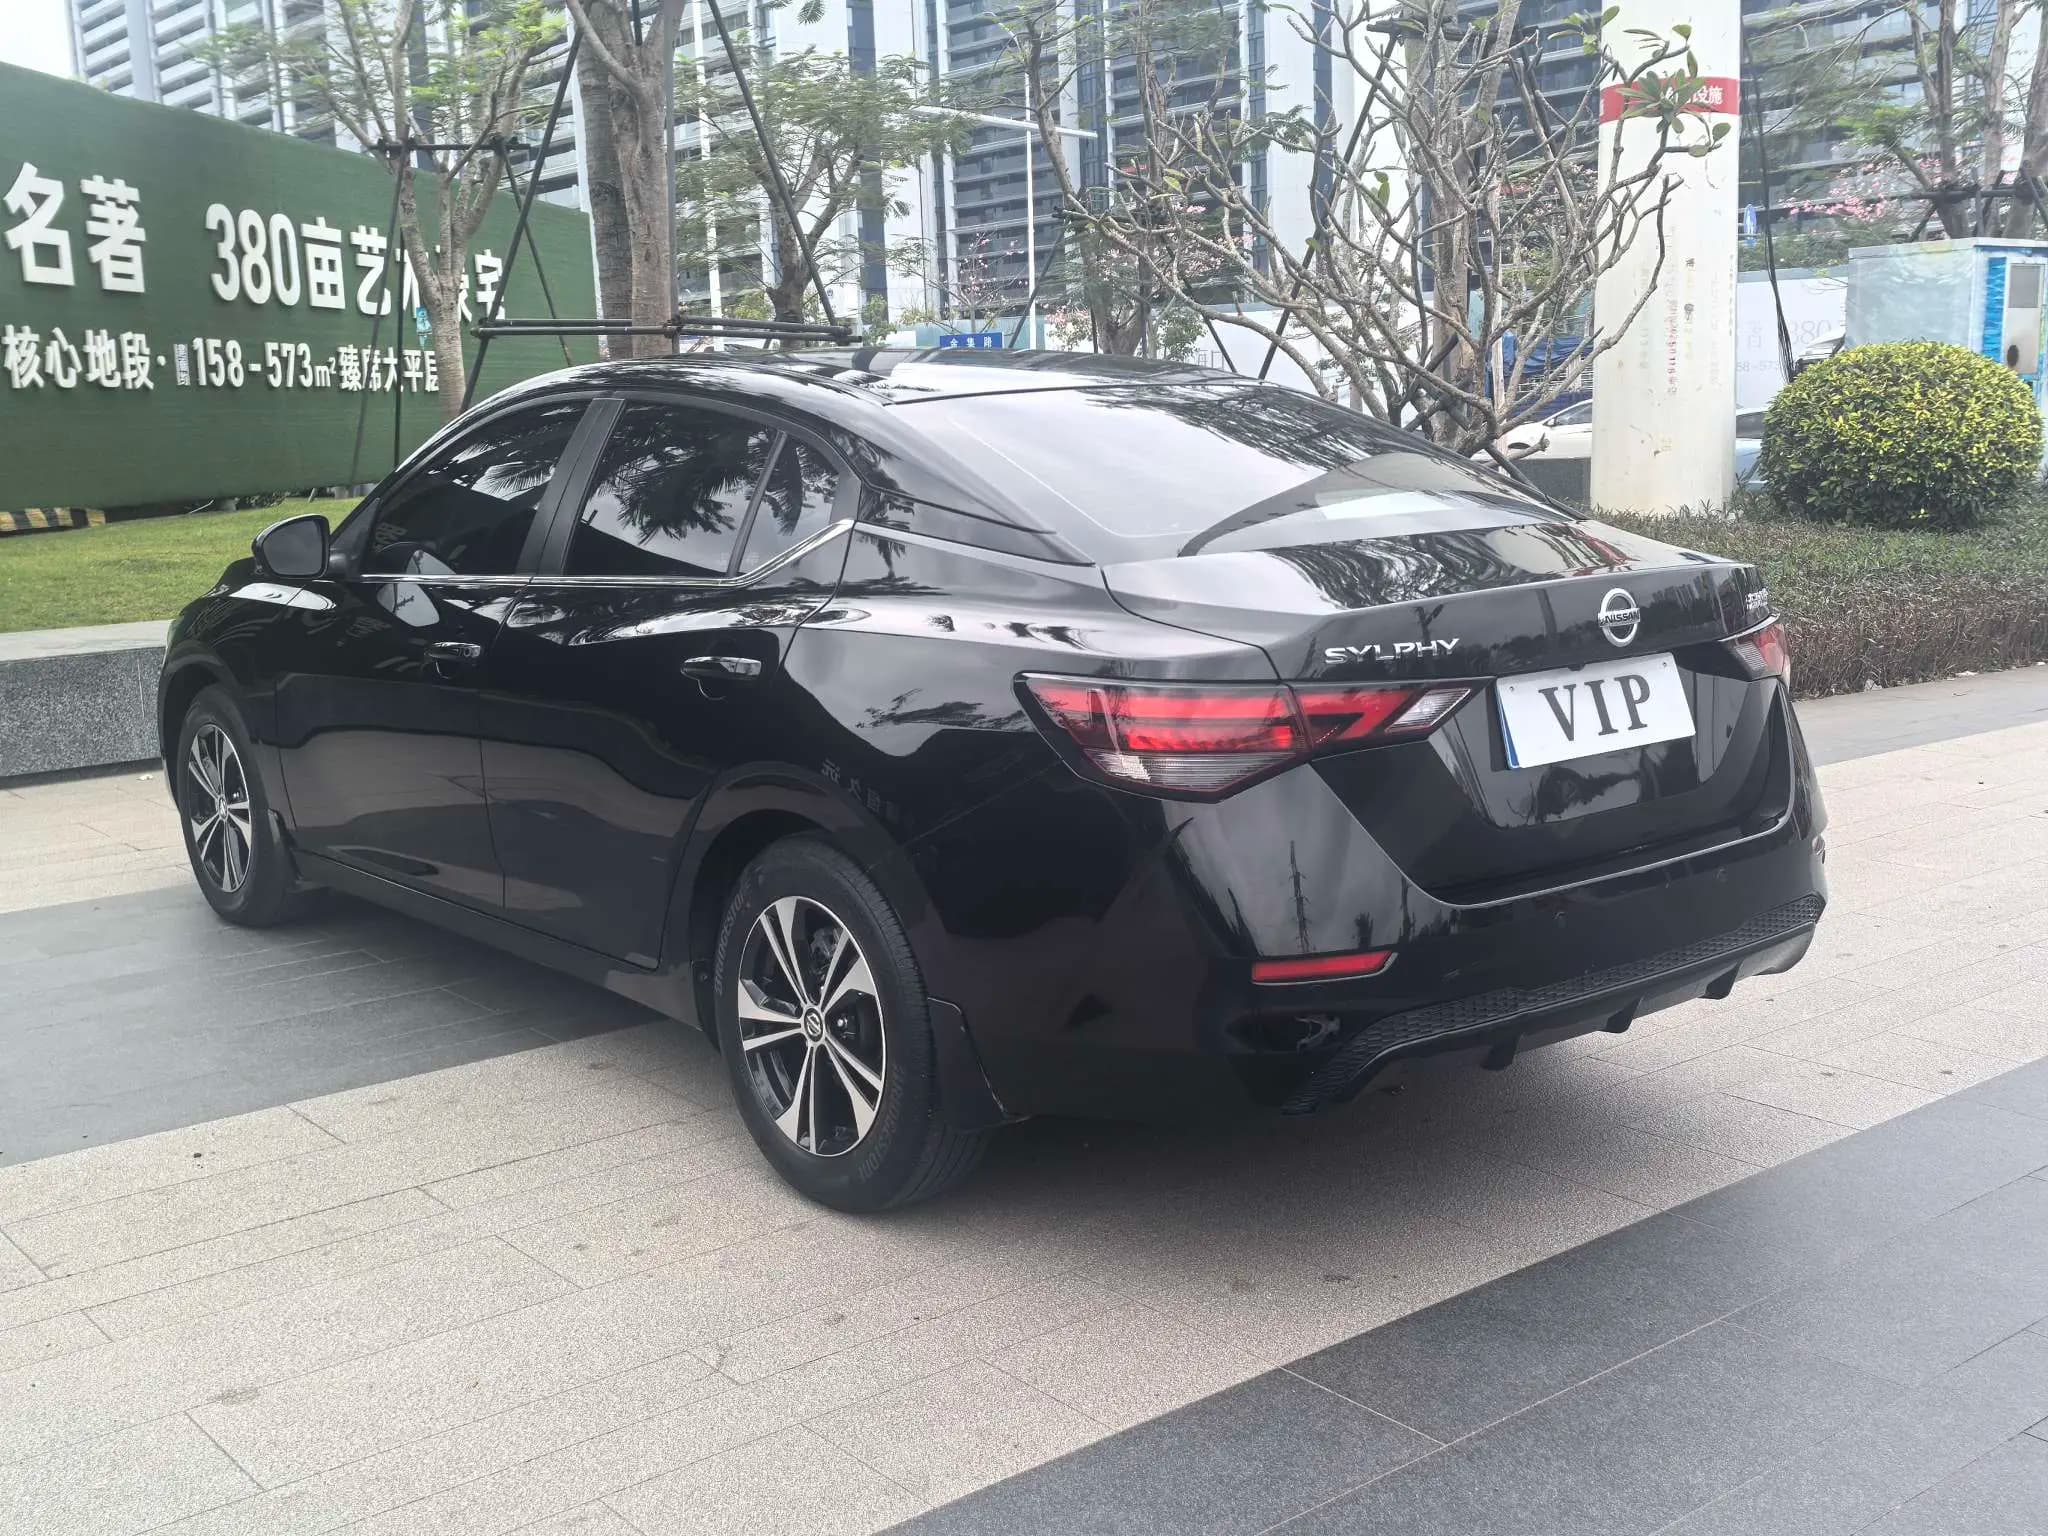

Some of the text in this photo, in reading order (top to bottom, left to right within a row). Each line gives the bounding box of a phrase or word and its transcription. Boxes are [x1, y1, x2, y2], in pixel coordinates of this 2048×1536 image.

[3, 162, 506, 321] 名著 380亩艺宅
[1604, 609, 1640, 624] NISSAN
[1324, 637, 1460, 664] SYLPHY
[1538, 674, 1651, 742] VIP
